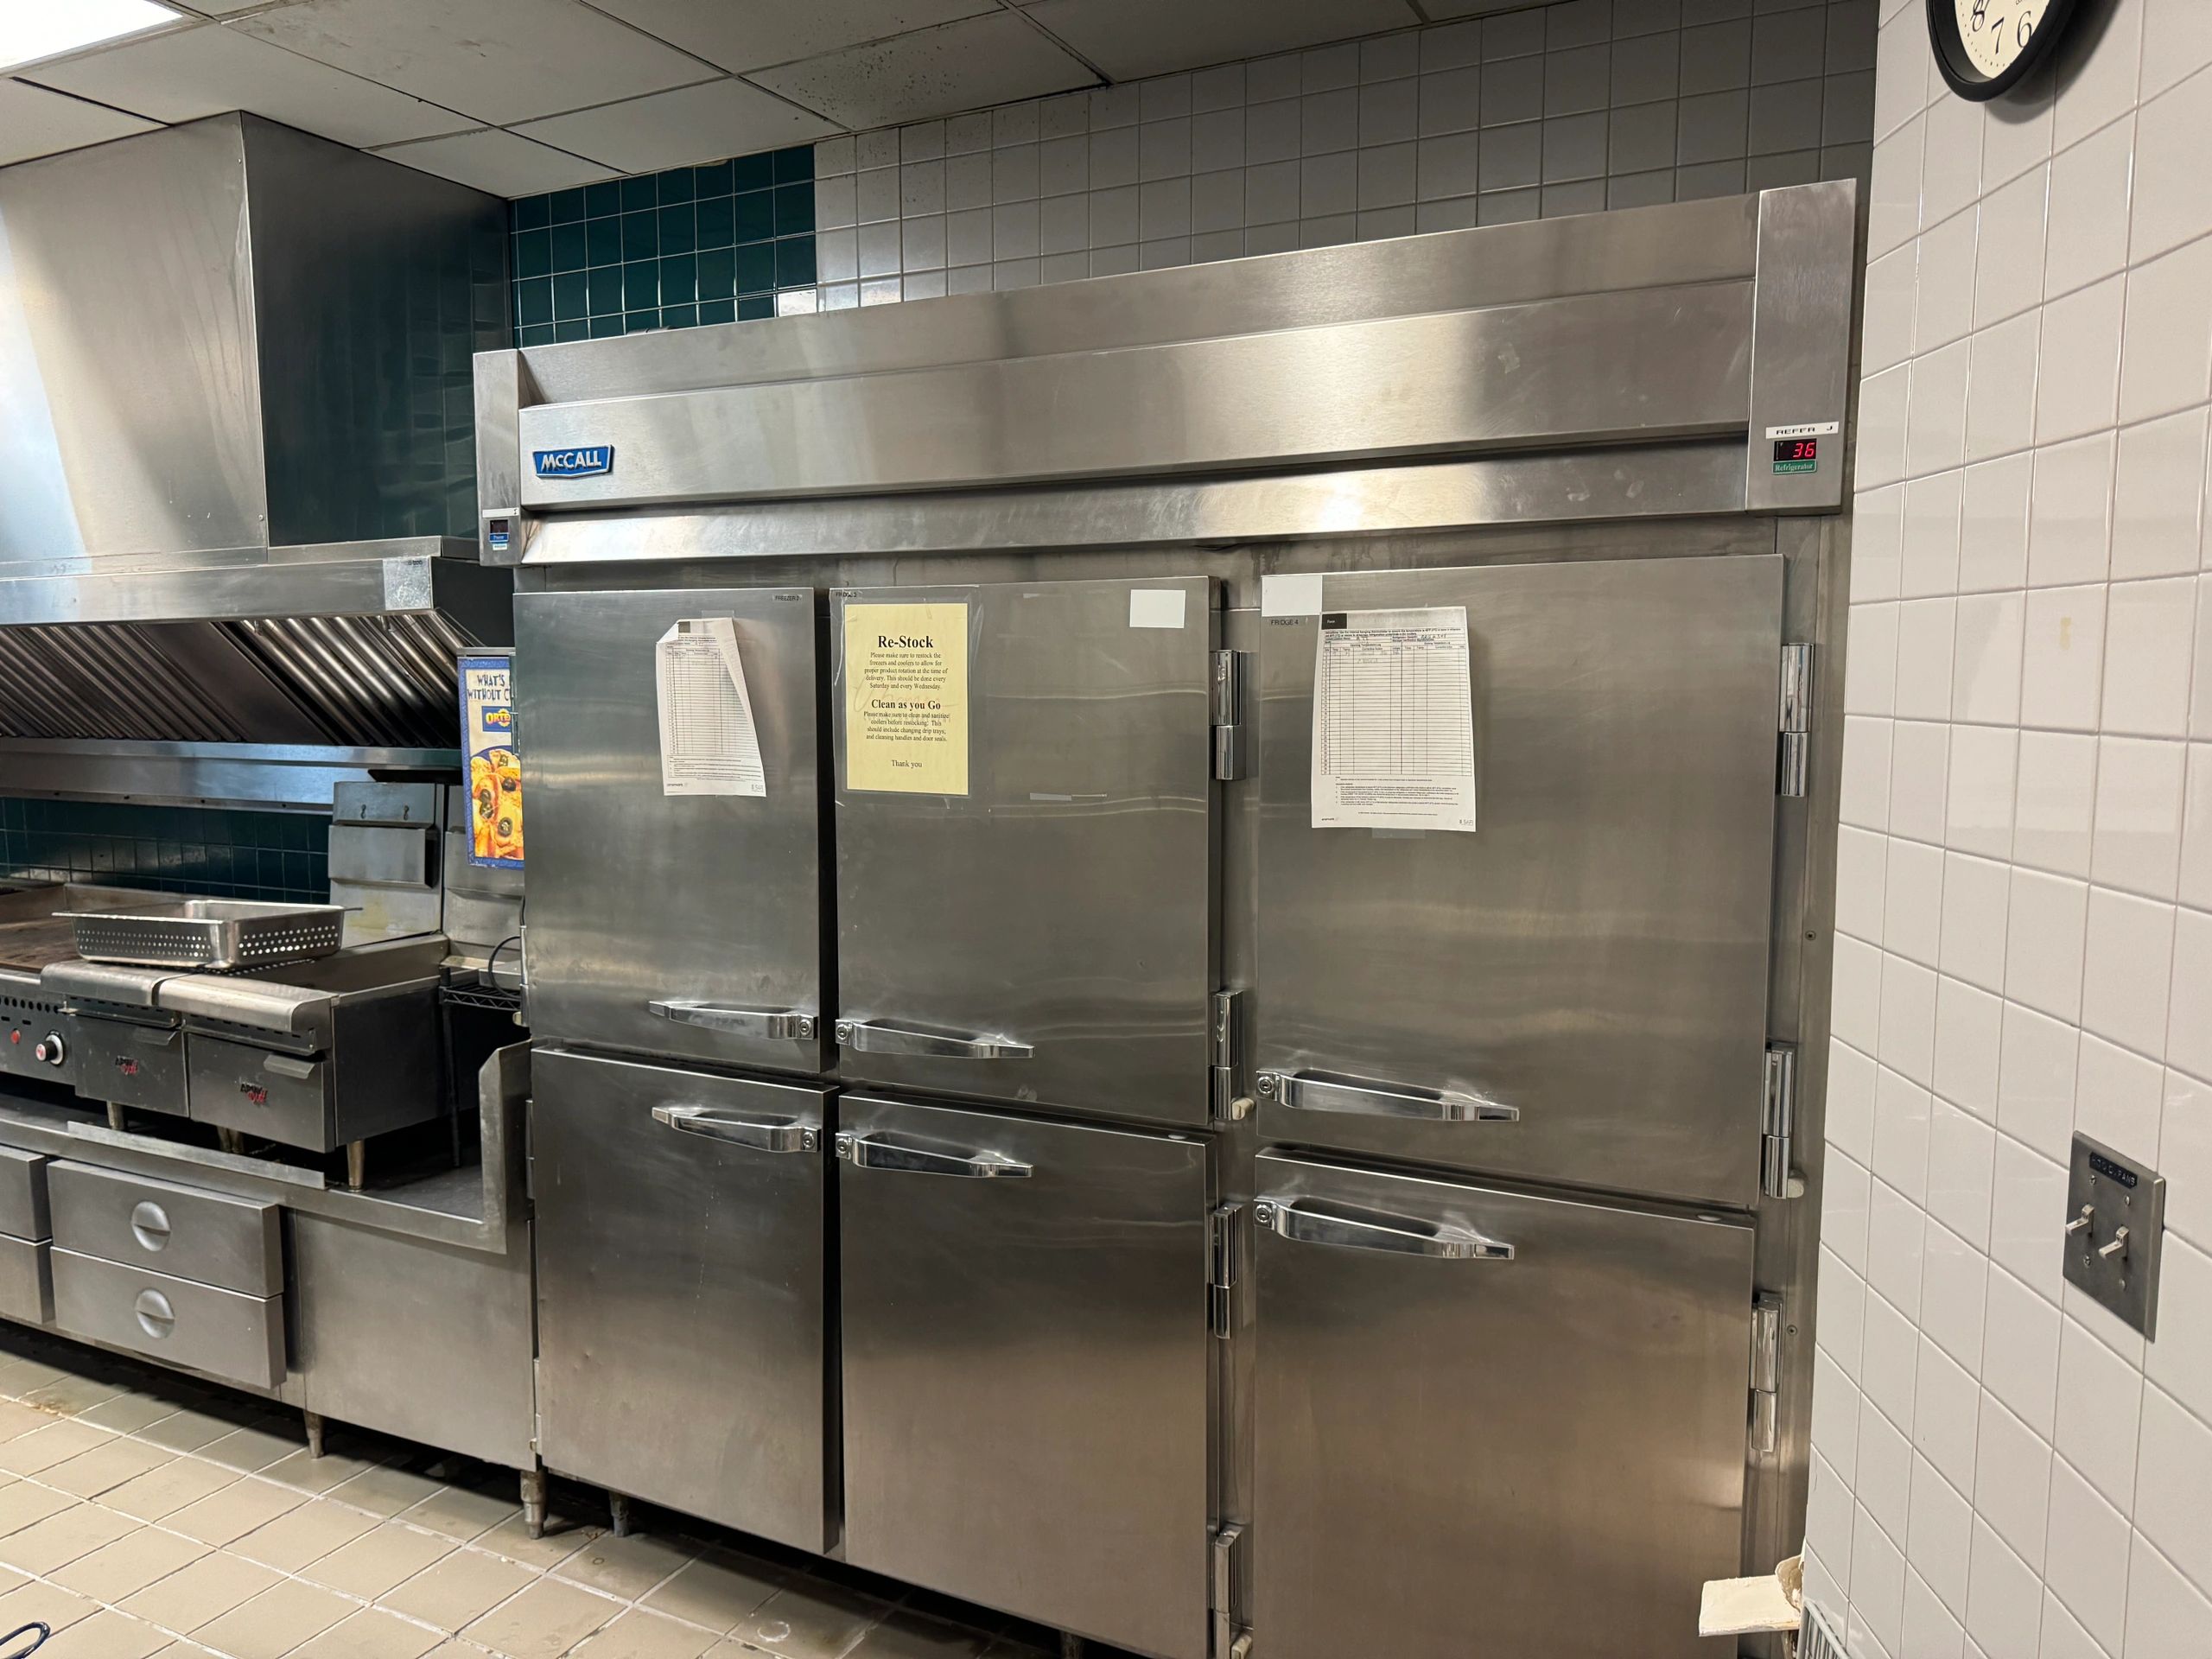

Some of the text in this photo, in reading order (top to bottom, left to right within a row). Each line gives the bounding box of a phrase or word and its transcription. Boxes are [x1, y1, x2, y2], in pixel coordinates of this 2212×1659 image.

[1991, 16, 2005, 54] 7
[2017, 10, 2032, 48] 6
[1792, 442, 1815, 458] 36
[1775, 463, 1814, 472] Refrigerator
[878, 635, 933, 648] Re-Stock
[477, 674, 505, 686] WHAT'S
[467, 689, 501, 700] WITHOUT
[871, 699, 895, 709] Clean
[909, 702, 925, 711] you
[928, 700, 940, 709] Go
